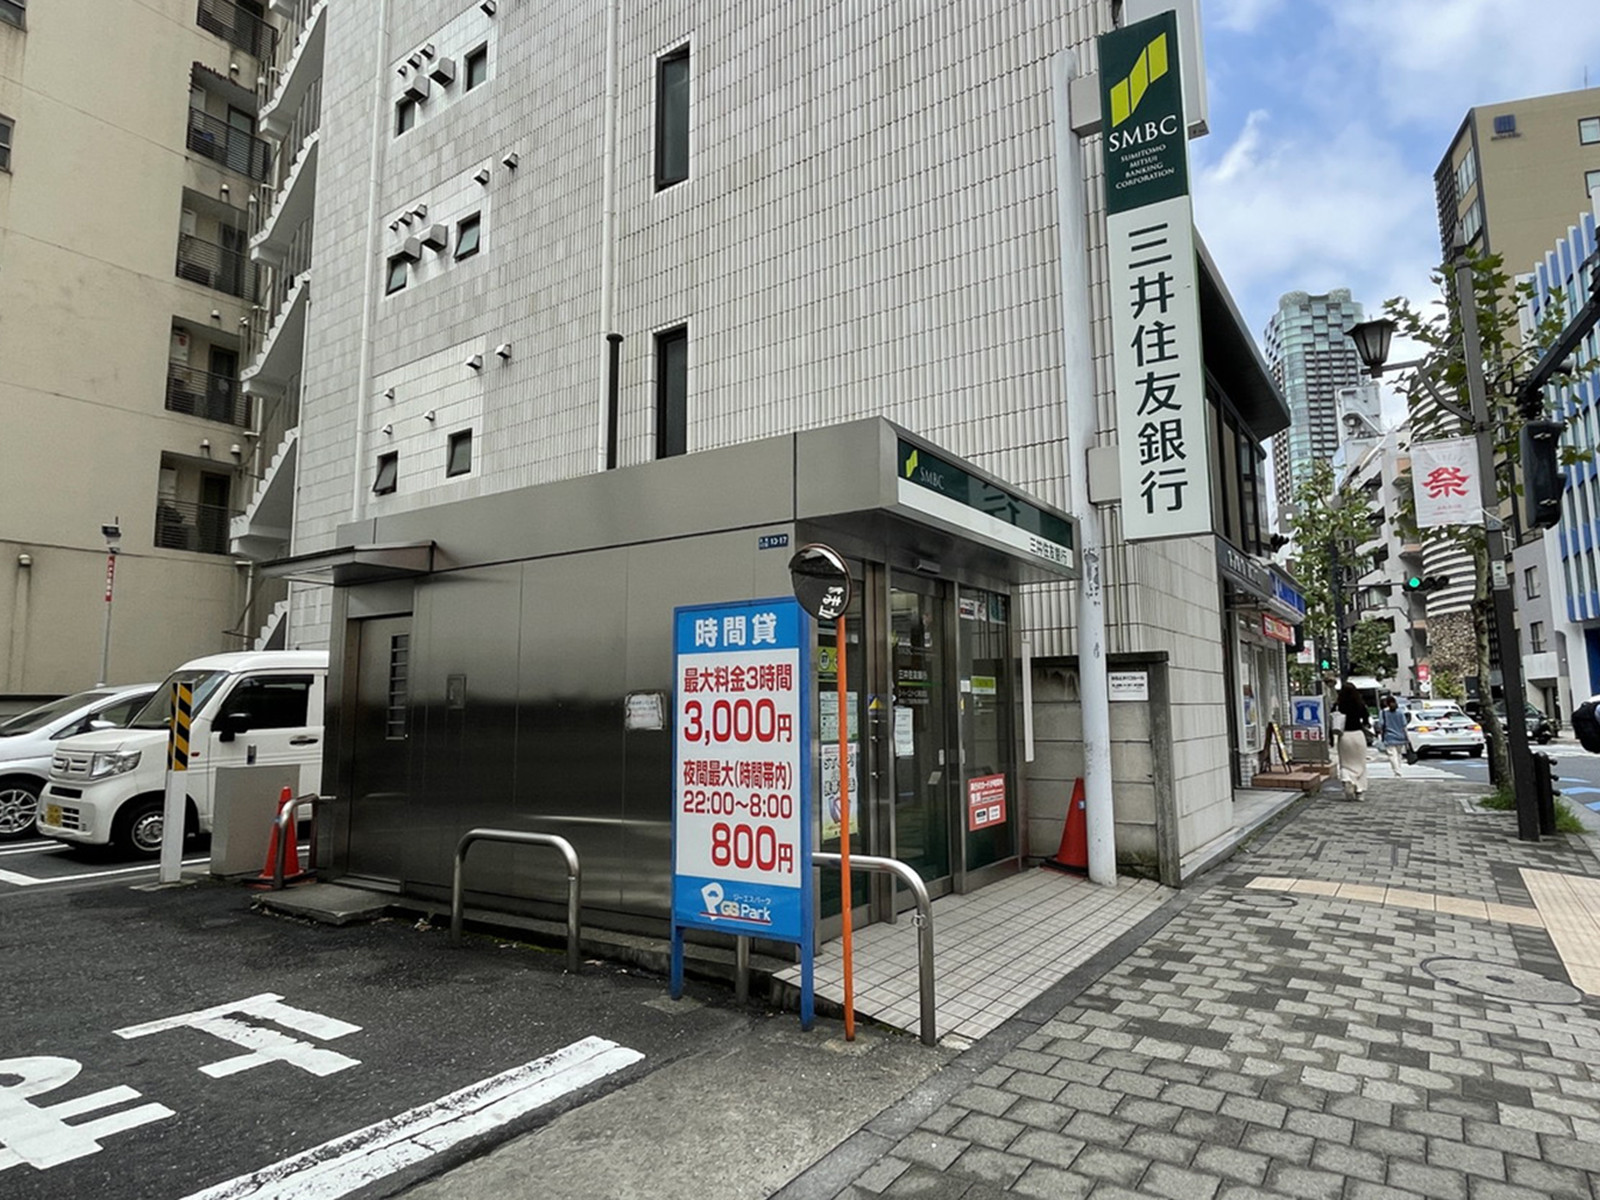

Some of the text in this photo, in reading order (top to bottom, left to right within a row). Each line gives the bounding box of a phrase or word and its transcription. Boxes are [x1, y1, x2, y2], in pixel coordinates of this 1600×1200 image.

[1109, 115, 1178, 152] SMBC
[1120, 143, 1167, 162] SUMITOMO
[1129, 155, 1158, 168] MITSUI
[1115, 167, 1175, 189] CORPORATION
[1125, 161, 1164, 178] BANKING
[1128, 222, 1188, 514] 三井住友銀行
[920, 466, 945, 490] SMBC
[1421, 466, 1471, 499] 祭
[695, 612, 777, 648] 時間貸
[684, 664, 792, 693] 最大料金3時間
[684, 698, 792, 746] 3,000円
[683, 759, 793, 790] 夜間最大(時間帯内)
[711, 822, 793, 874] 800円
